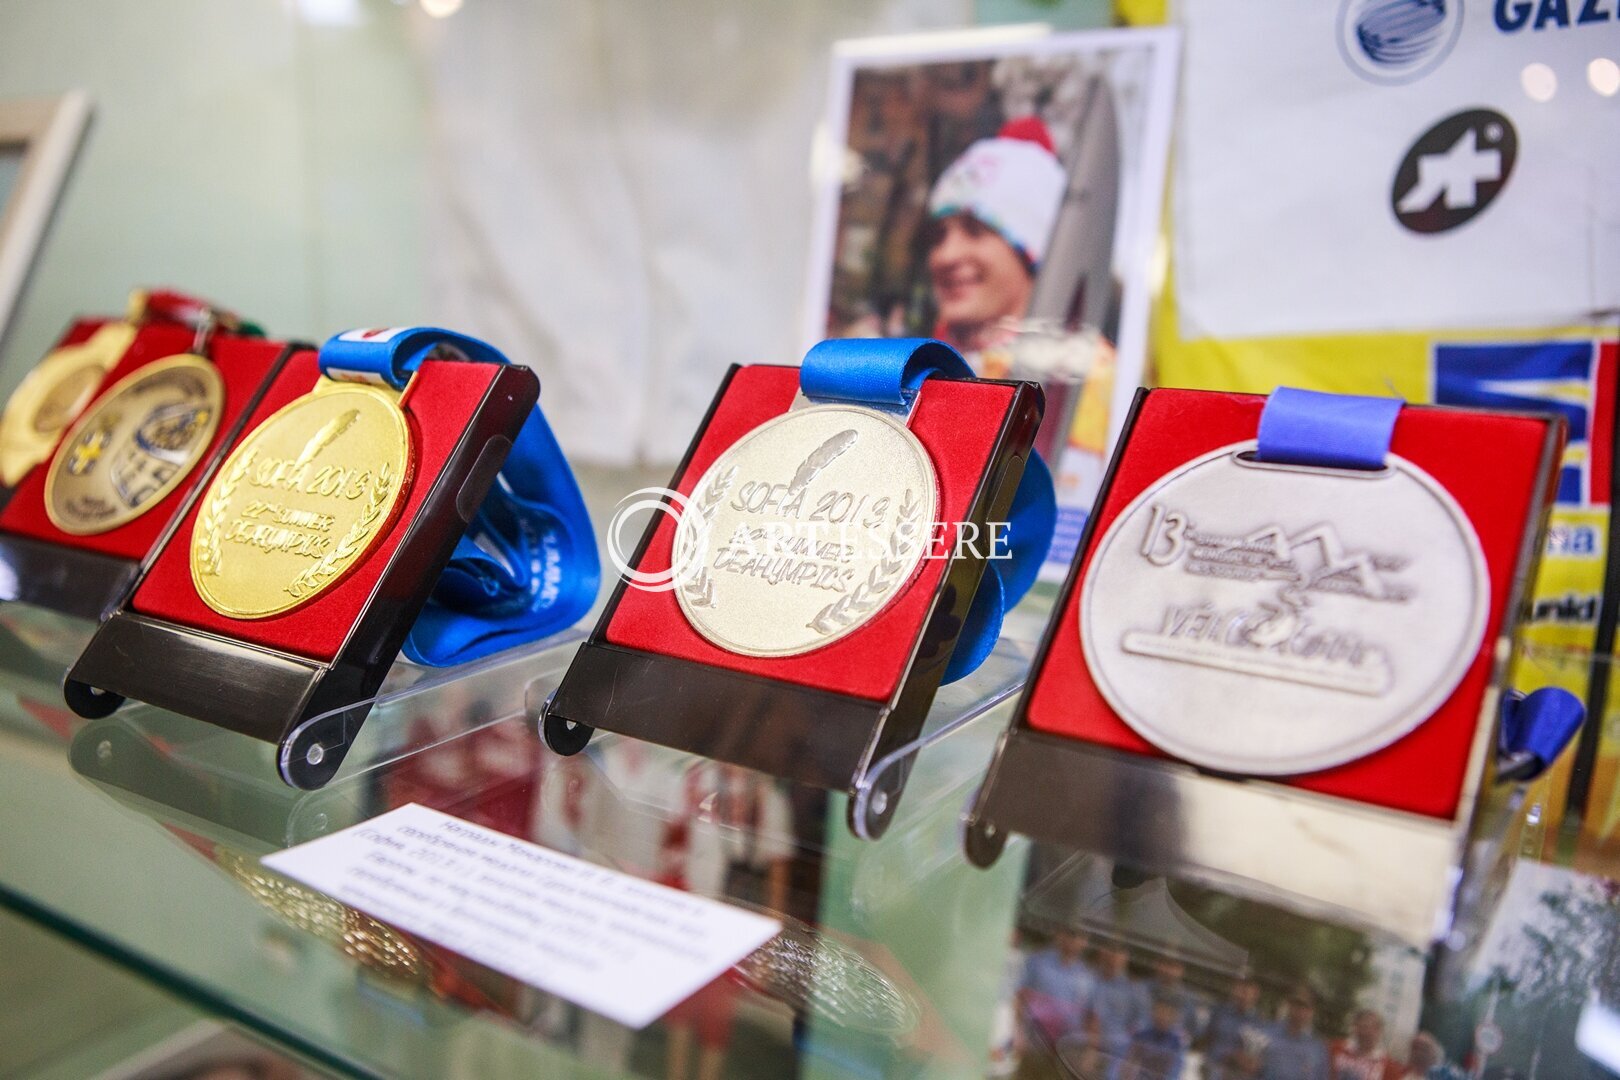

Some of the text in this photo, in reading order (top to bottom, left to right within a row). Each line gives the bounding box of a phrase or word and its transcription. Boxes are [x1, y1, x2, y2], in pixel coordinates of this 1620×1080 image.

[1493, 0, 1620, 34] GAZ
[249, 457, 372, 499] SOFIA 2013
[730, 480, 890, 528] SOFIA 2013
